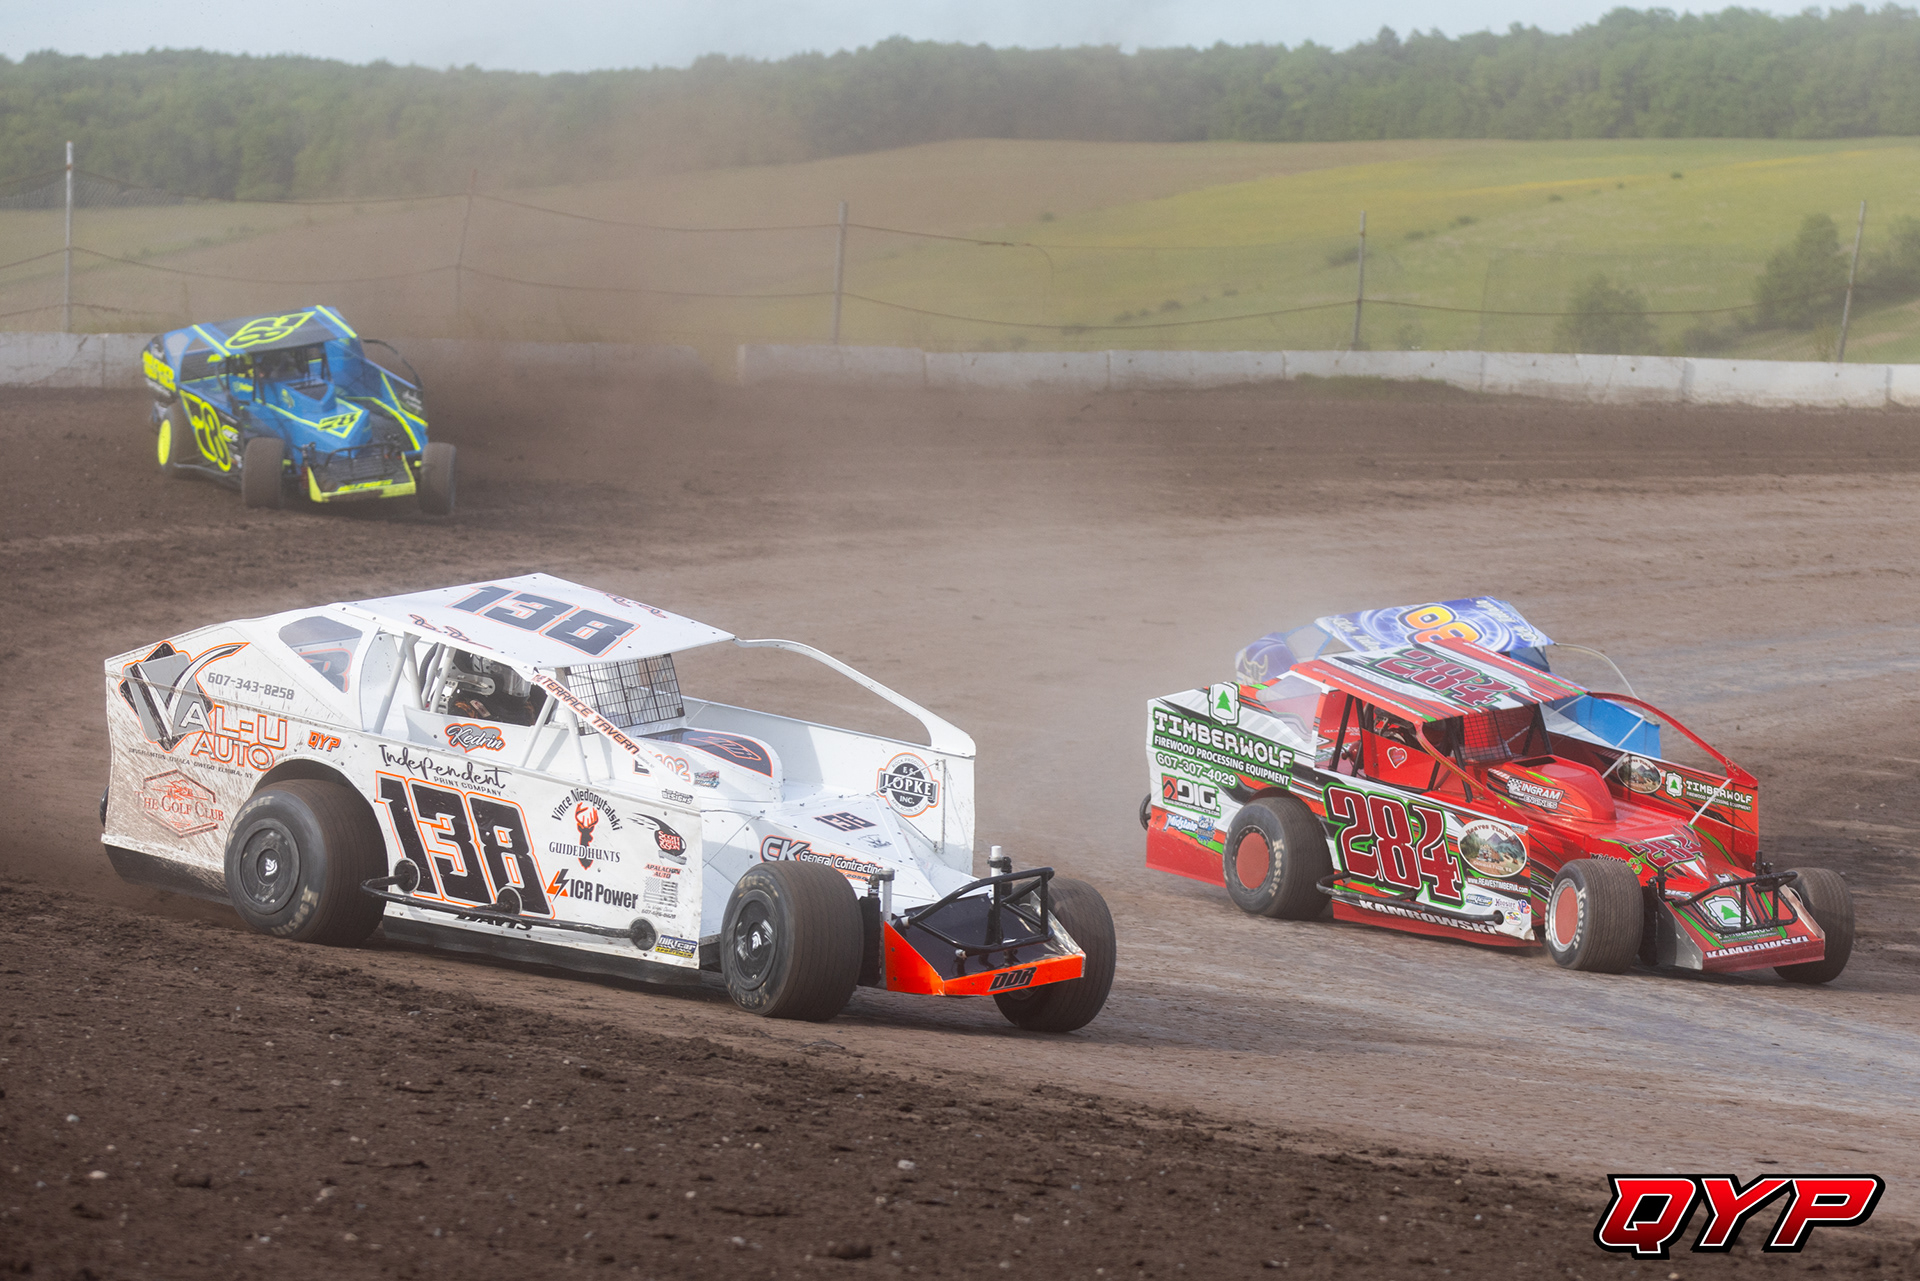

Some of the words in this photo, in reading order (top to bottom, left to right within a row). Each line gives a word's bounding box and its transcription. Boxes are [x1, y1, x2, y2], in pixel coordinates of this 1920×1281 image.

[450, 583, 641, 657] 138
[207, 672, 295, 700] 607-343-8258
[1372, 650, 1514, 707] 284
[540, 676, 595, 718] TERRACE
[592, 714, 641, 756] TAVERN
[190, 731, 275, 772] AUTO
[308, 730, 342, 752] QYP
[446, 725, 504, 750] Kedrin
[1153, 709, 1294, 769] TIMBERWOLF
[378, 744, 512, 790] Independent
[1154, 735, 1196, 755] FIREWOOD
[1196, 747, 1245, 772] PROCESSING
[1245, 764, 1291, 787] EQUIPMENT
[1156, 753, 1237, 787] 607-307-4029
[433, 775, 460, 788] PRINT
[461, 781, 503, 797] COMPANY
[884, 774, 932, 796] LOPKE
[899, 795, 915, 805] INC.
[1520, 783, 1561, 800] INGRAM
[161, 795, 193, 815] GOLF
[195, 801, 225, 822] CLUB
[551, 795, 573, 822] Vince
[375, 771, 556, 919] 138
[548, 841, 586, 859] GUIDED
[587, 847, 621, 863] HUNTS
[761, 835, 810, 862] CK
[800, 851, 833, 866] General
[1328, 786, 1462, 900] 284
[1267, 838, 1285, 898] Hoosier
[569, 878, 593, 900] ICR
[595, 884, 639, 909] Power
[1358, 899, 1499, 935] KAMROWSKI
[1705, 935, 1810, 959] KAMROWSKI
